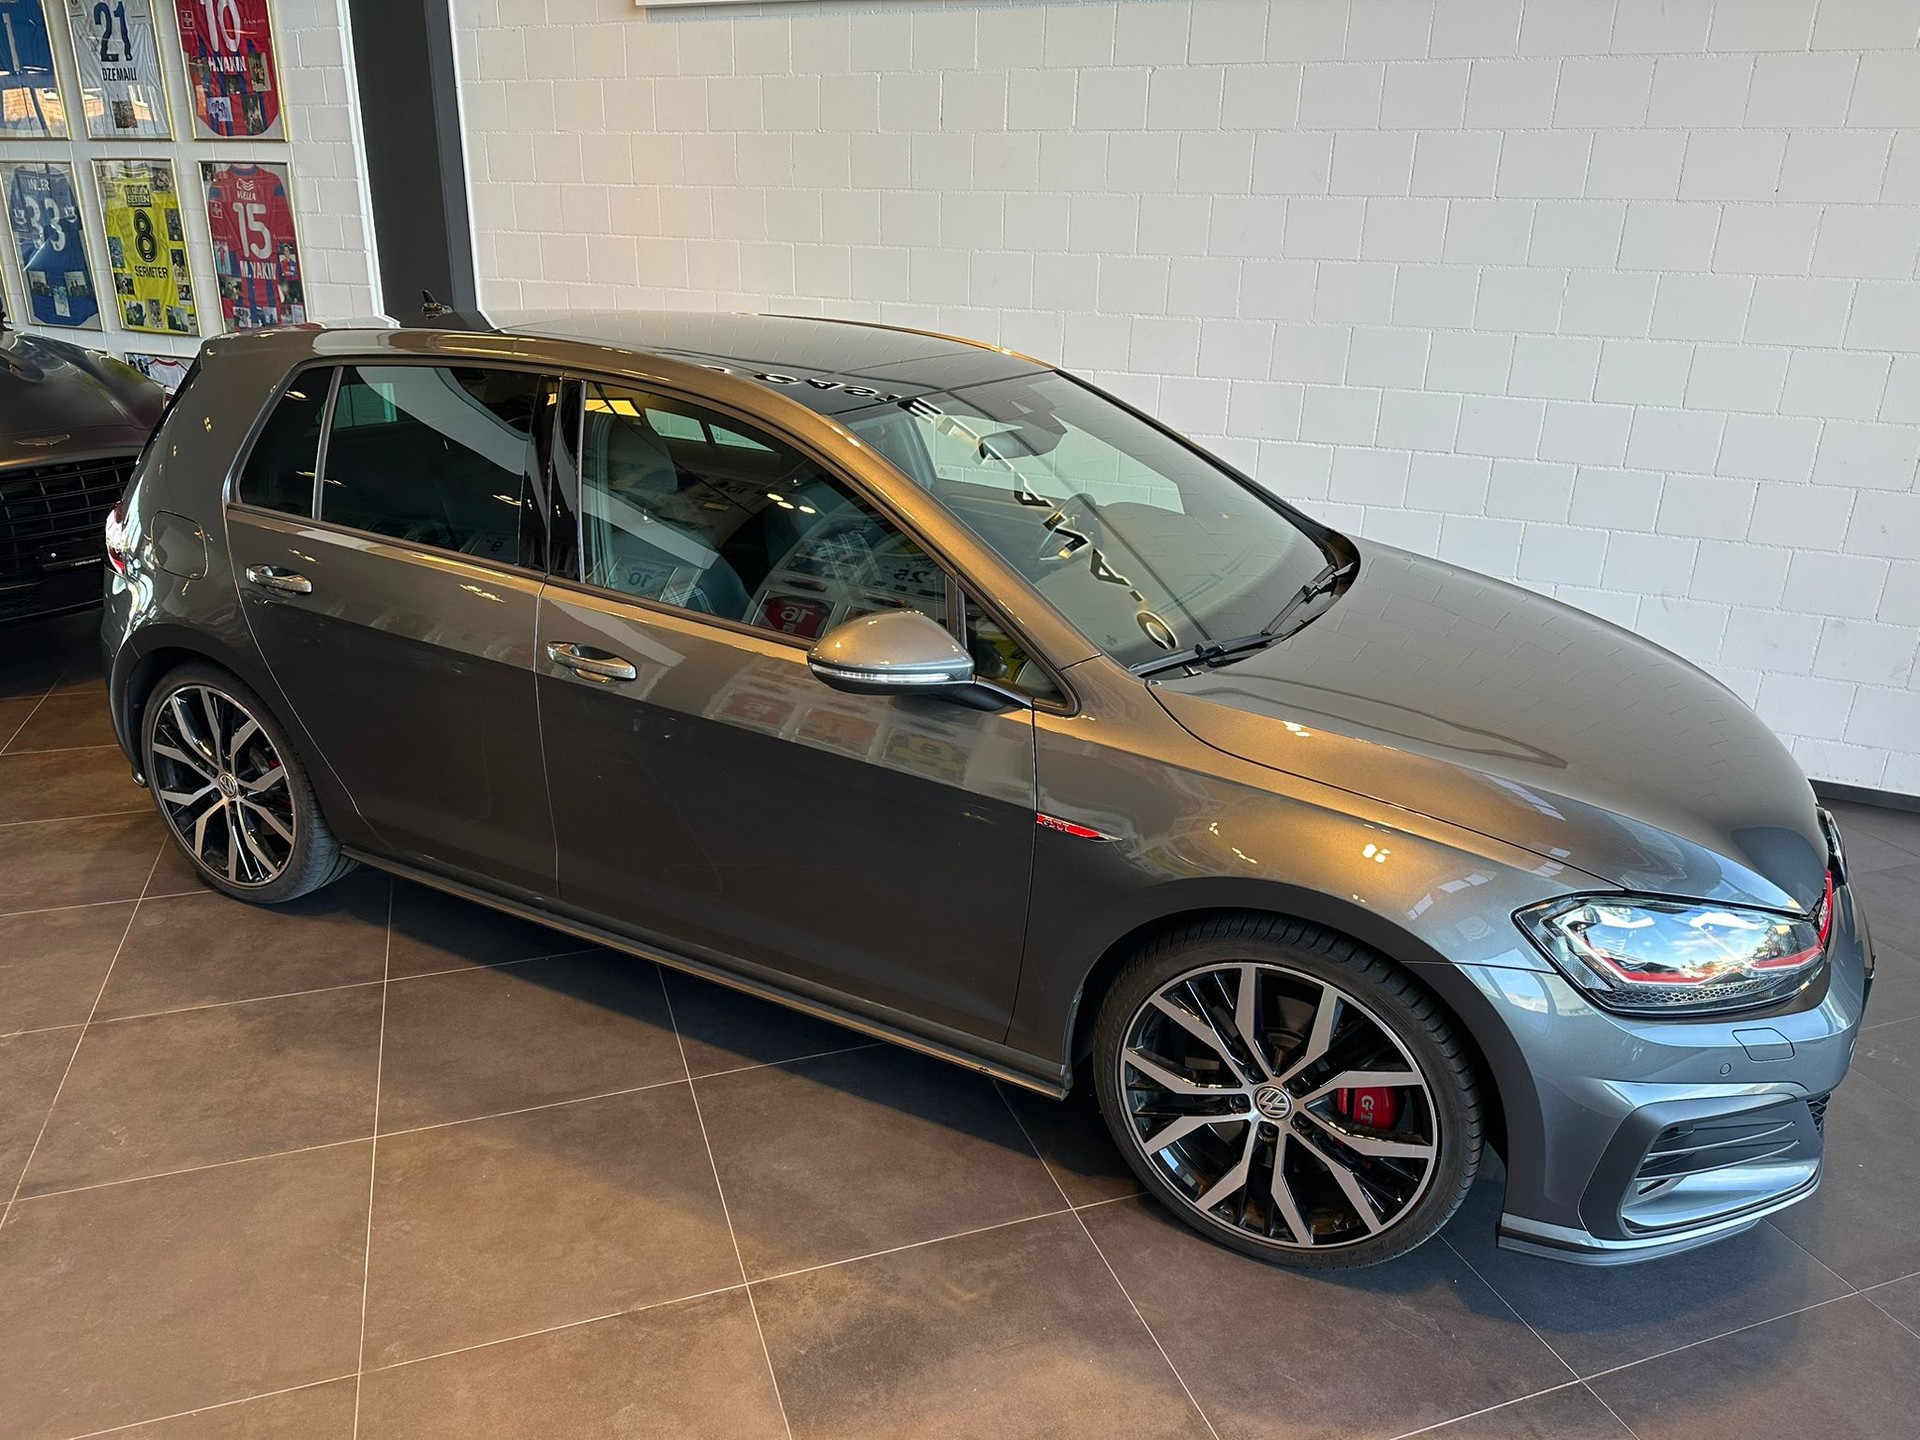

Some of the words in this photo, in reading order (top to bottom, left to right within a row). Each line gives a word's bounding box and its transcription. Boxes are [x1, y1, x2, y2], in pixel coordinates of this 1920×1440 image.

[94, 1, 132, 62] 21
[200, 0, 240, 52] 10
[208, 56, 247, 72] H.YAKIN
[23, 195, 66, 252] 33
[134, 209, 158, 262] 8
[232, 202, 272, 259] 15
[240, 261, 276, 279] M.YAKIN
